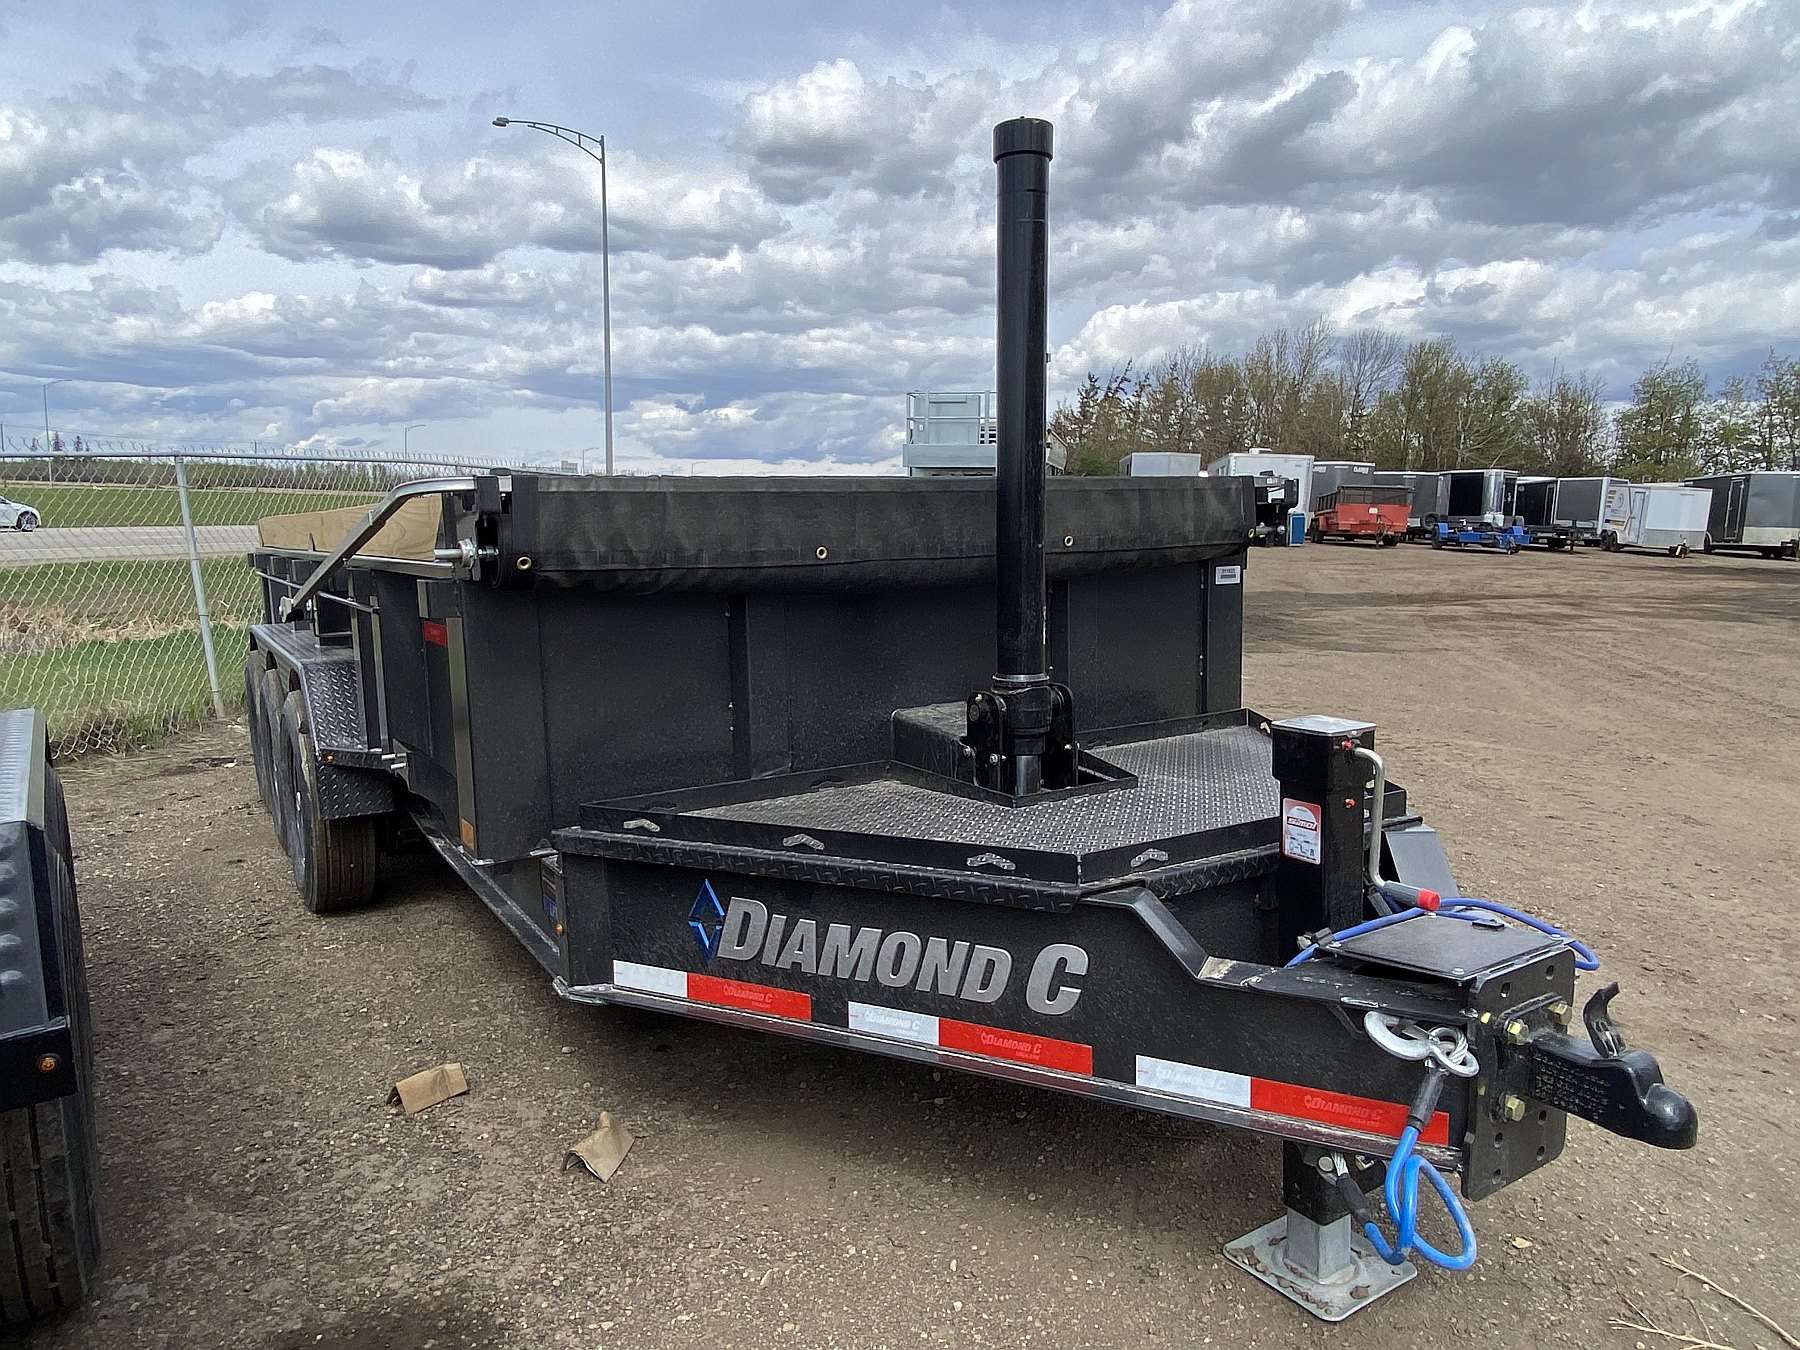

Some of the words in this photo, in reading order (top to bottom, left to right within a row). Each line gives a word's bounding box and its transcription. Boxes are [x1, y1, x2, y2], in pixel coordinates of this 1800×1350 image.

[717, 896, 1012, 1003] DIAMOND
[1026, 943, 1089, 1015] C
[1033, 1043, 1043, 1055] C
